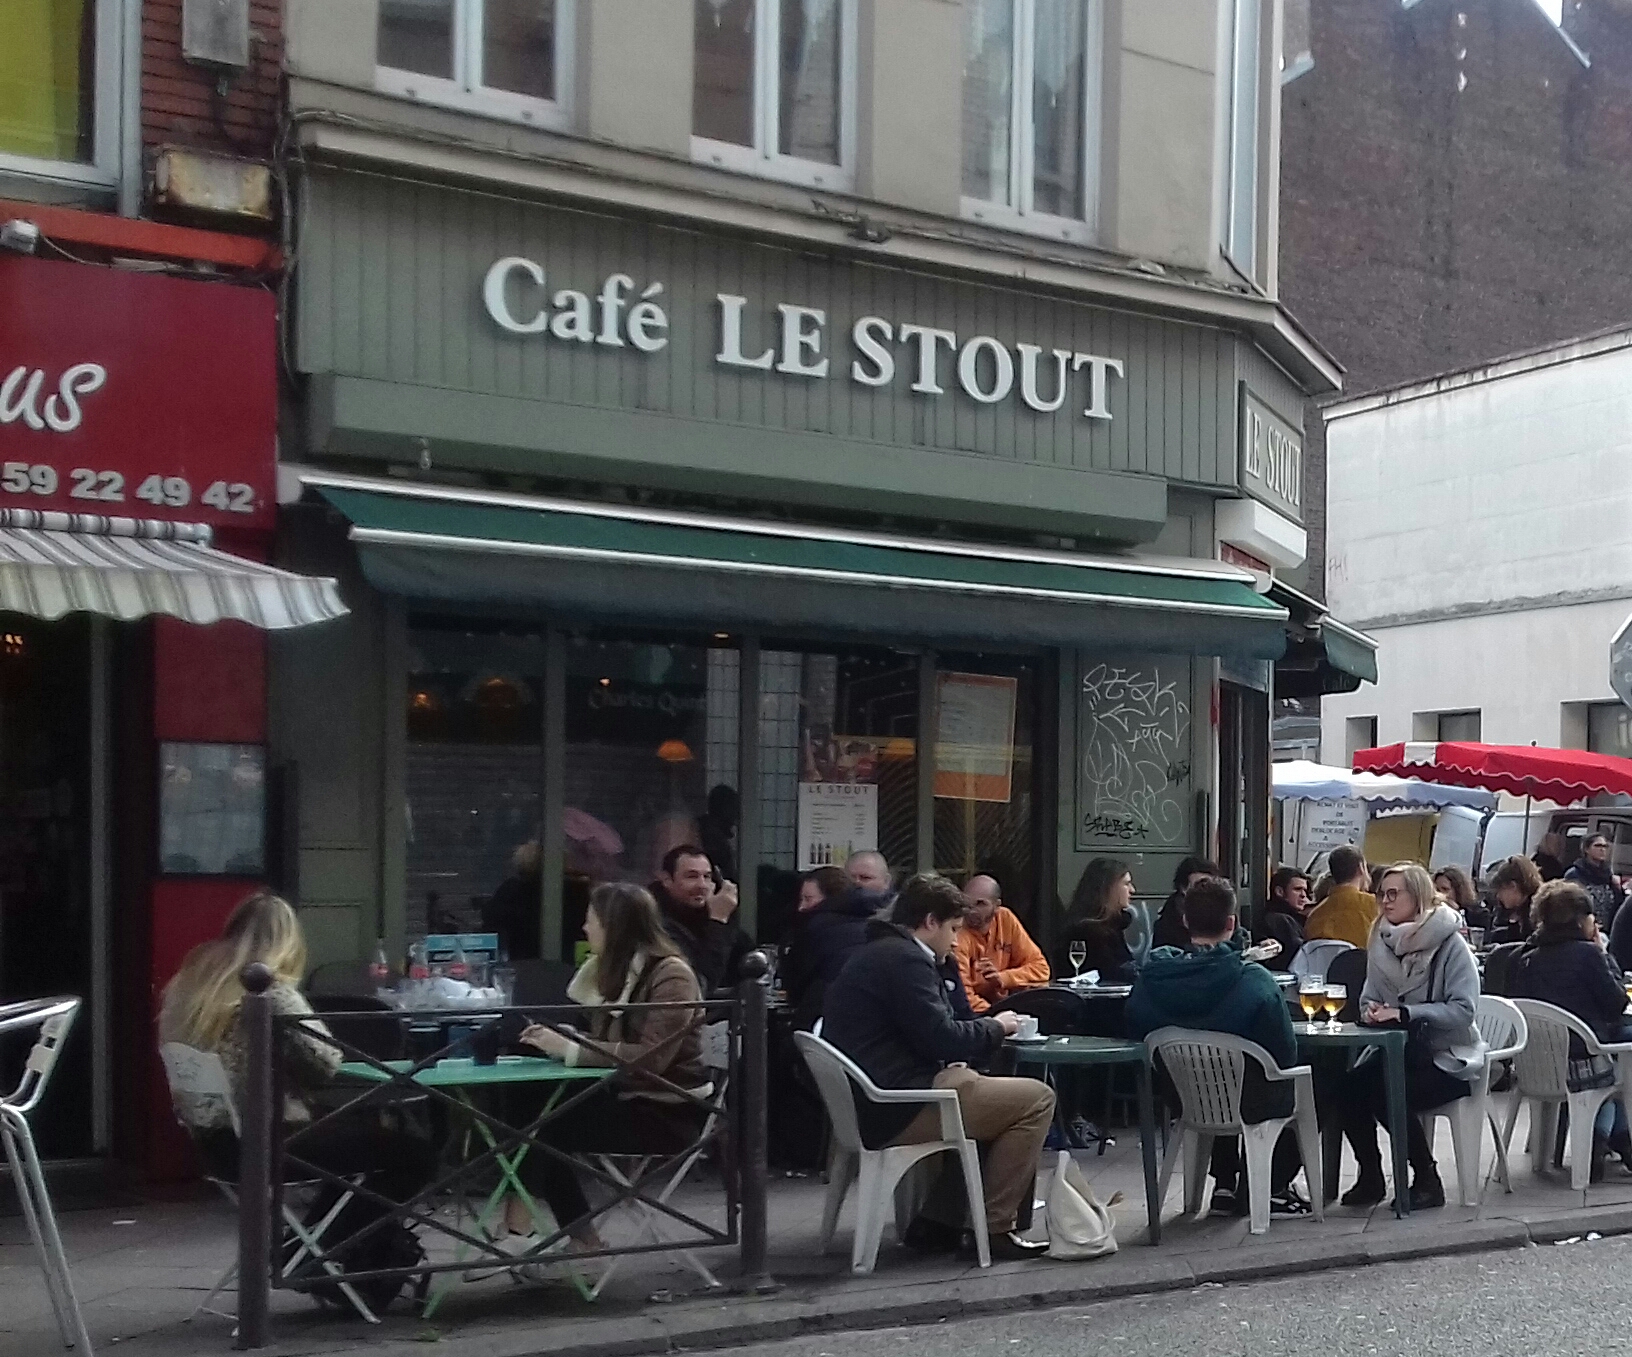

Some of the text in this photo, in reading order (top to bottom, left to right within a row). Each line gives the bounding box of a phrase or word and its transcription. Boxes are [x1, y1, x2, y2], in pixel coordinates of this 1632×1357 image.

[483, 256, 1124, 421] Café LE STOUT
[1, 462, 255, 513] 59 22 49 42
[1246, 405, 1300, 507] LE STOUT
[808, 785, 868, 795] LE STOUT
